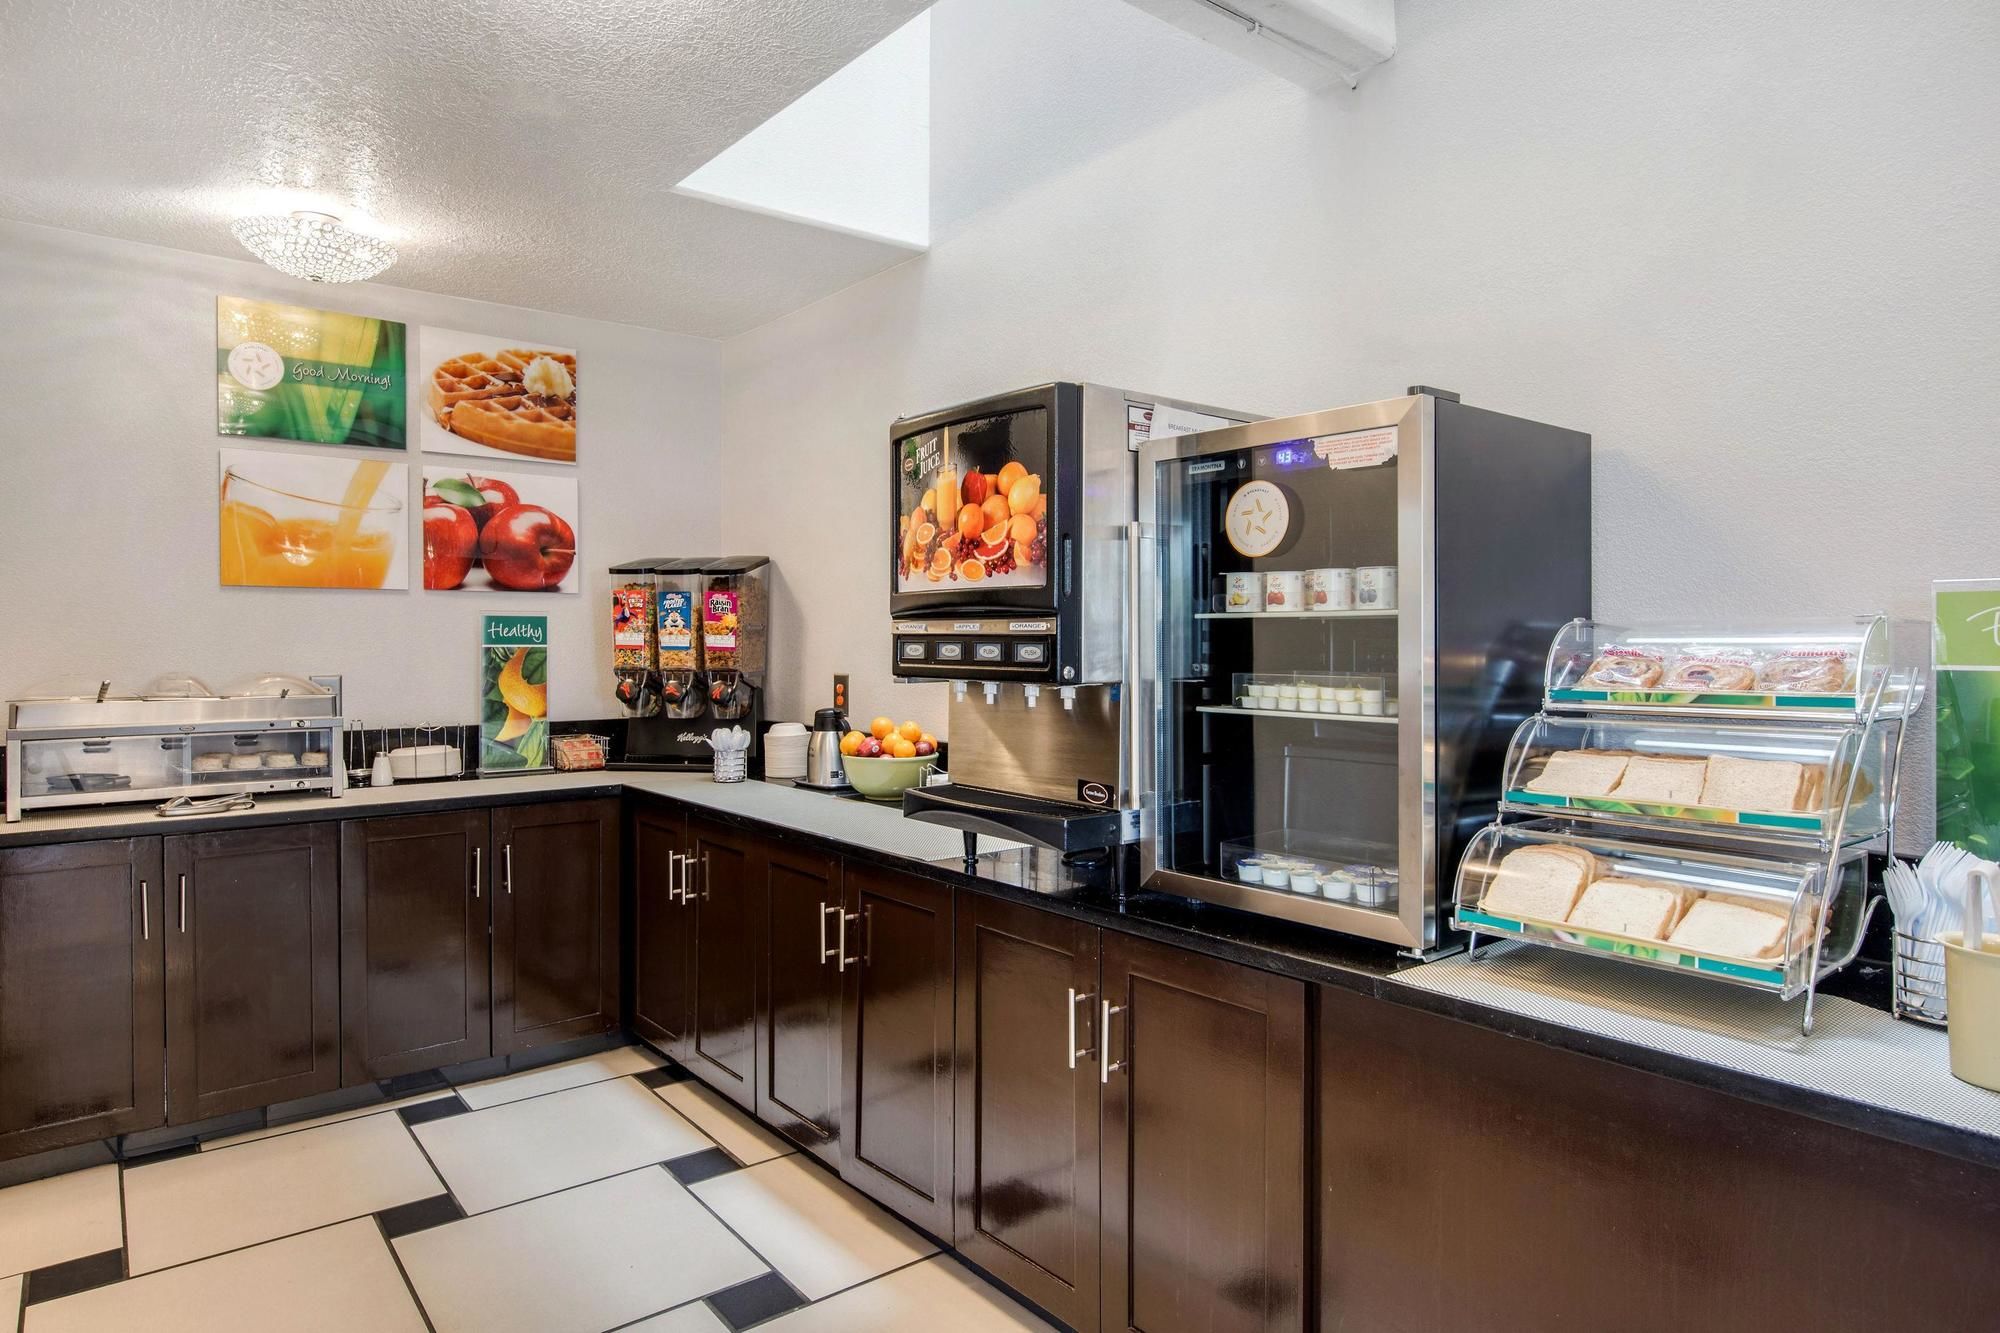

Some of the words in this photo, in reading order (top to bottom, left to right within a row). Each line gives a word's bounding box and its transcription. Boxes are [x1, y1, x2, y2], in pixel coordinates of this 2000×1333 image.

[292, 362, 325, 381] Good
[327, 367, 392, 391] Morning!
[916, 437, 938, 464] FRUIT
[1278, 451, 1292, 463] 43
[919, 452, 941, 479] JUICE
[709, 599, 732, 608] Raisin
[711, 605, 729, 613] Bran
[487, 621, 543, 643] Healthy
[676, 733, 707, 744] Kellogg's
